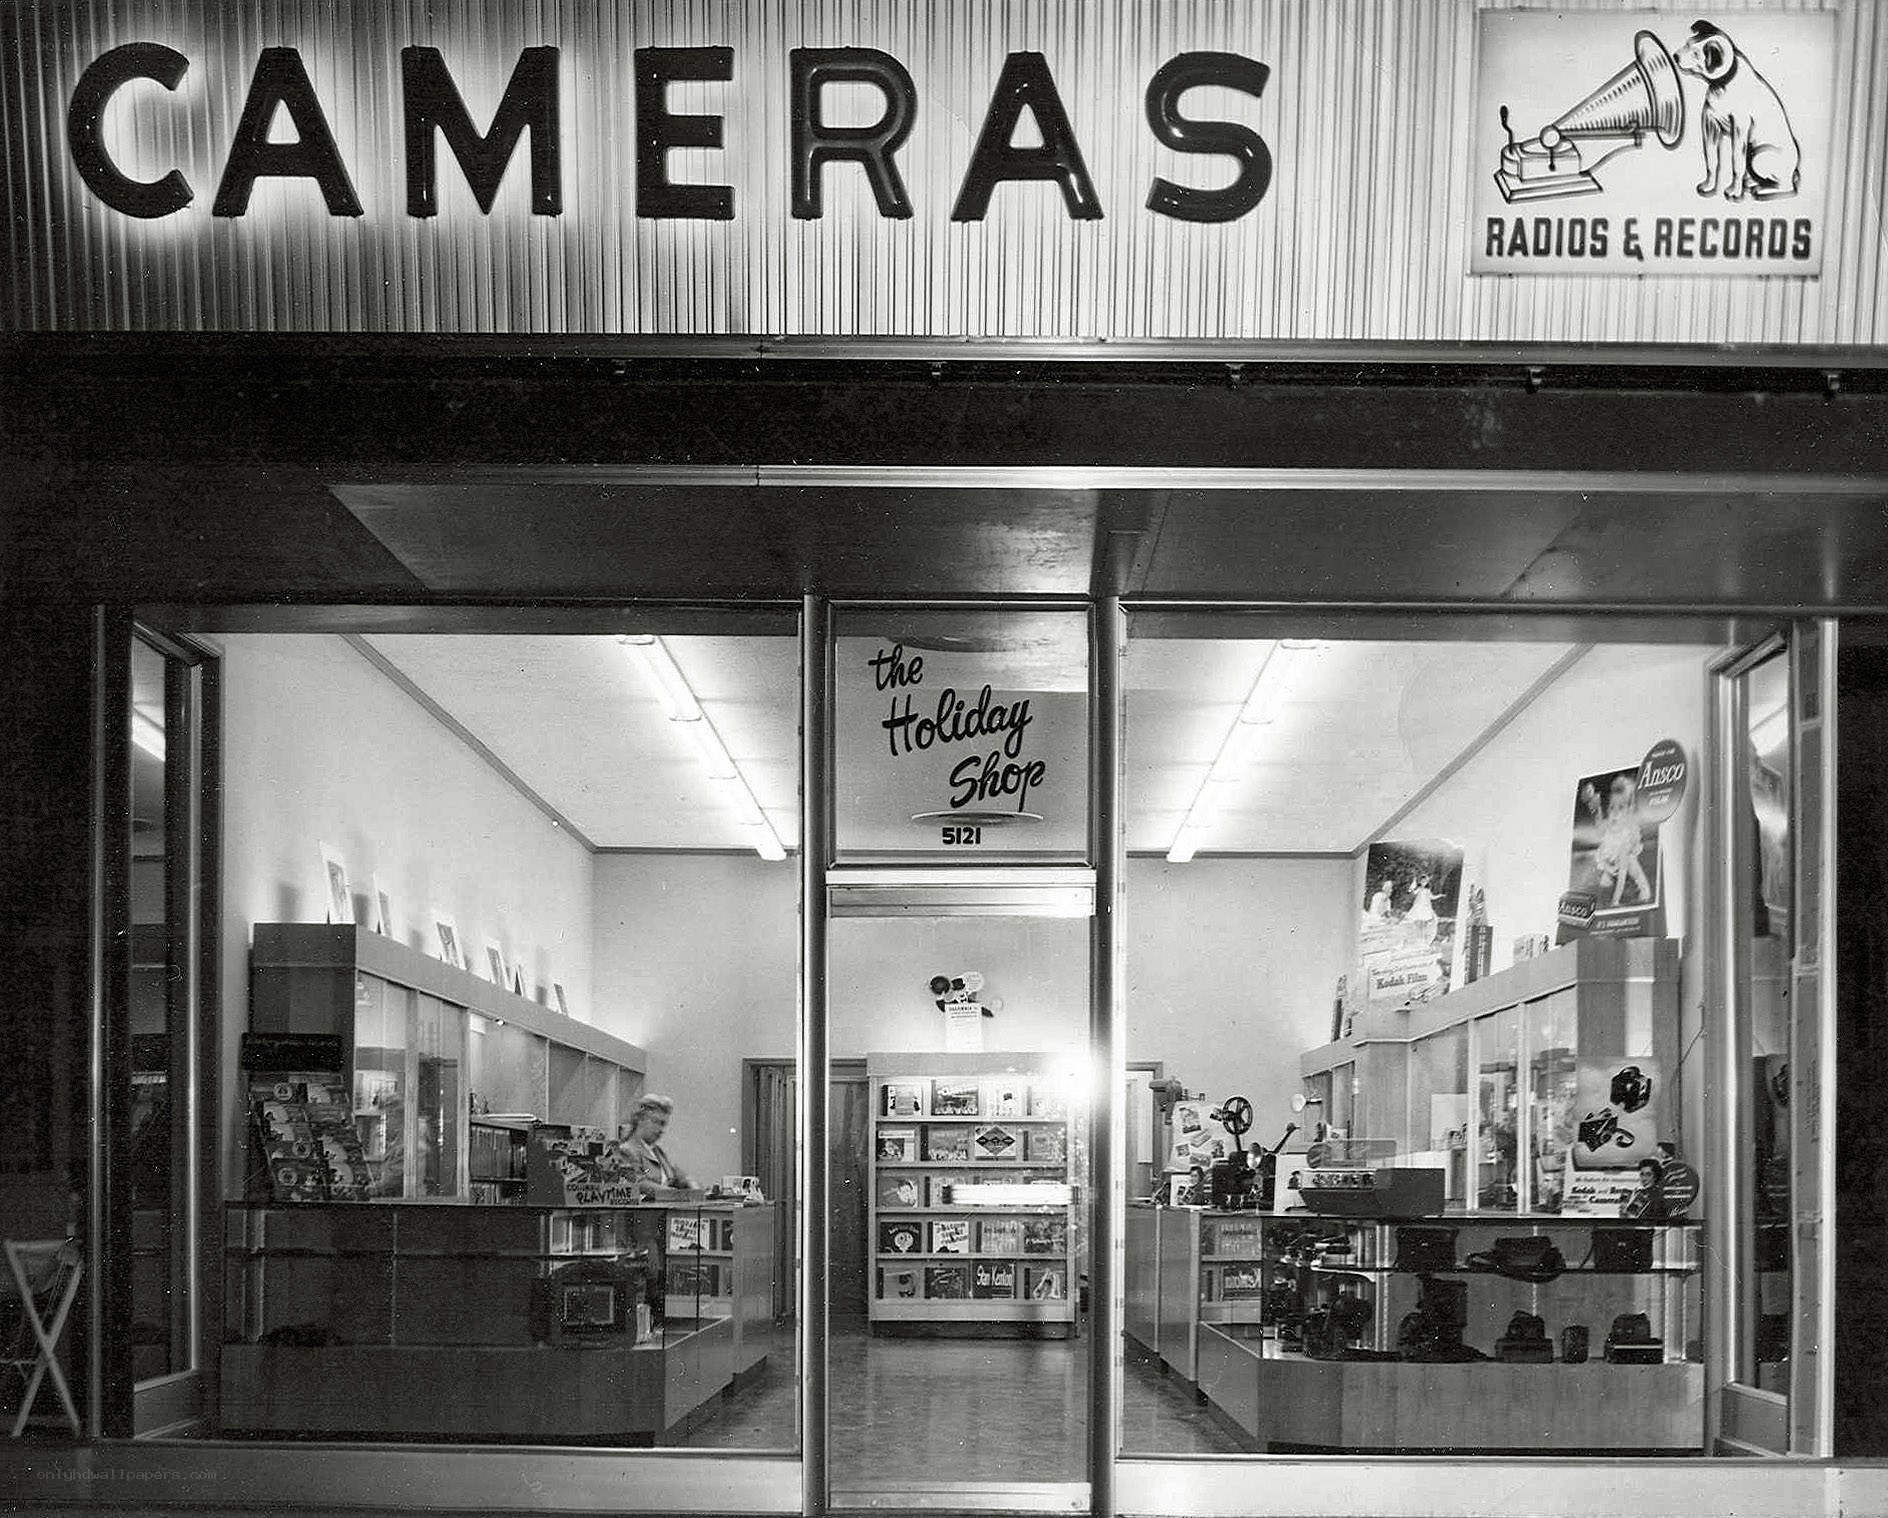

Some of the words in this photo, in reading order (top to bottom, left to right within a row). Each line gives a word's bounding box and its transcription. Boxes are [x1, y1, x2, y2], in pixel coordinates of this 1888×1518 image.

[68, 44, 1272, 224] CAMERAS
[1486, 216, 1608, 258] RADIOS
[1623, 217, 1644, 261] &
[1654, 217, 1812, 260] RECORDS
[868, 643, 923, 691] the
[882, 684, 1033, 759] Holiday
[949, 750, 1046, 813] Shop
[1638, 761, 1685, 790] Ansco
[942, 827, 981, 845] 5121
